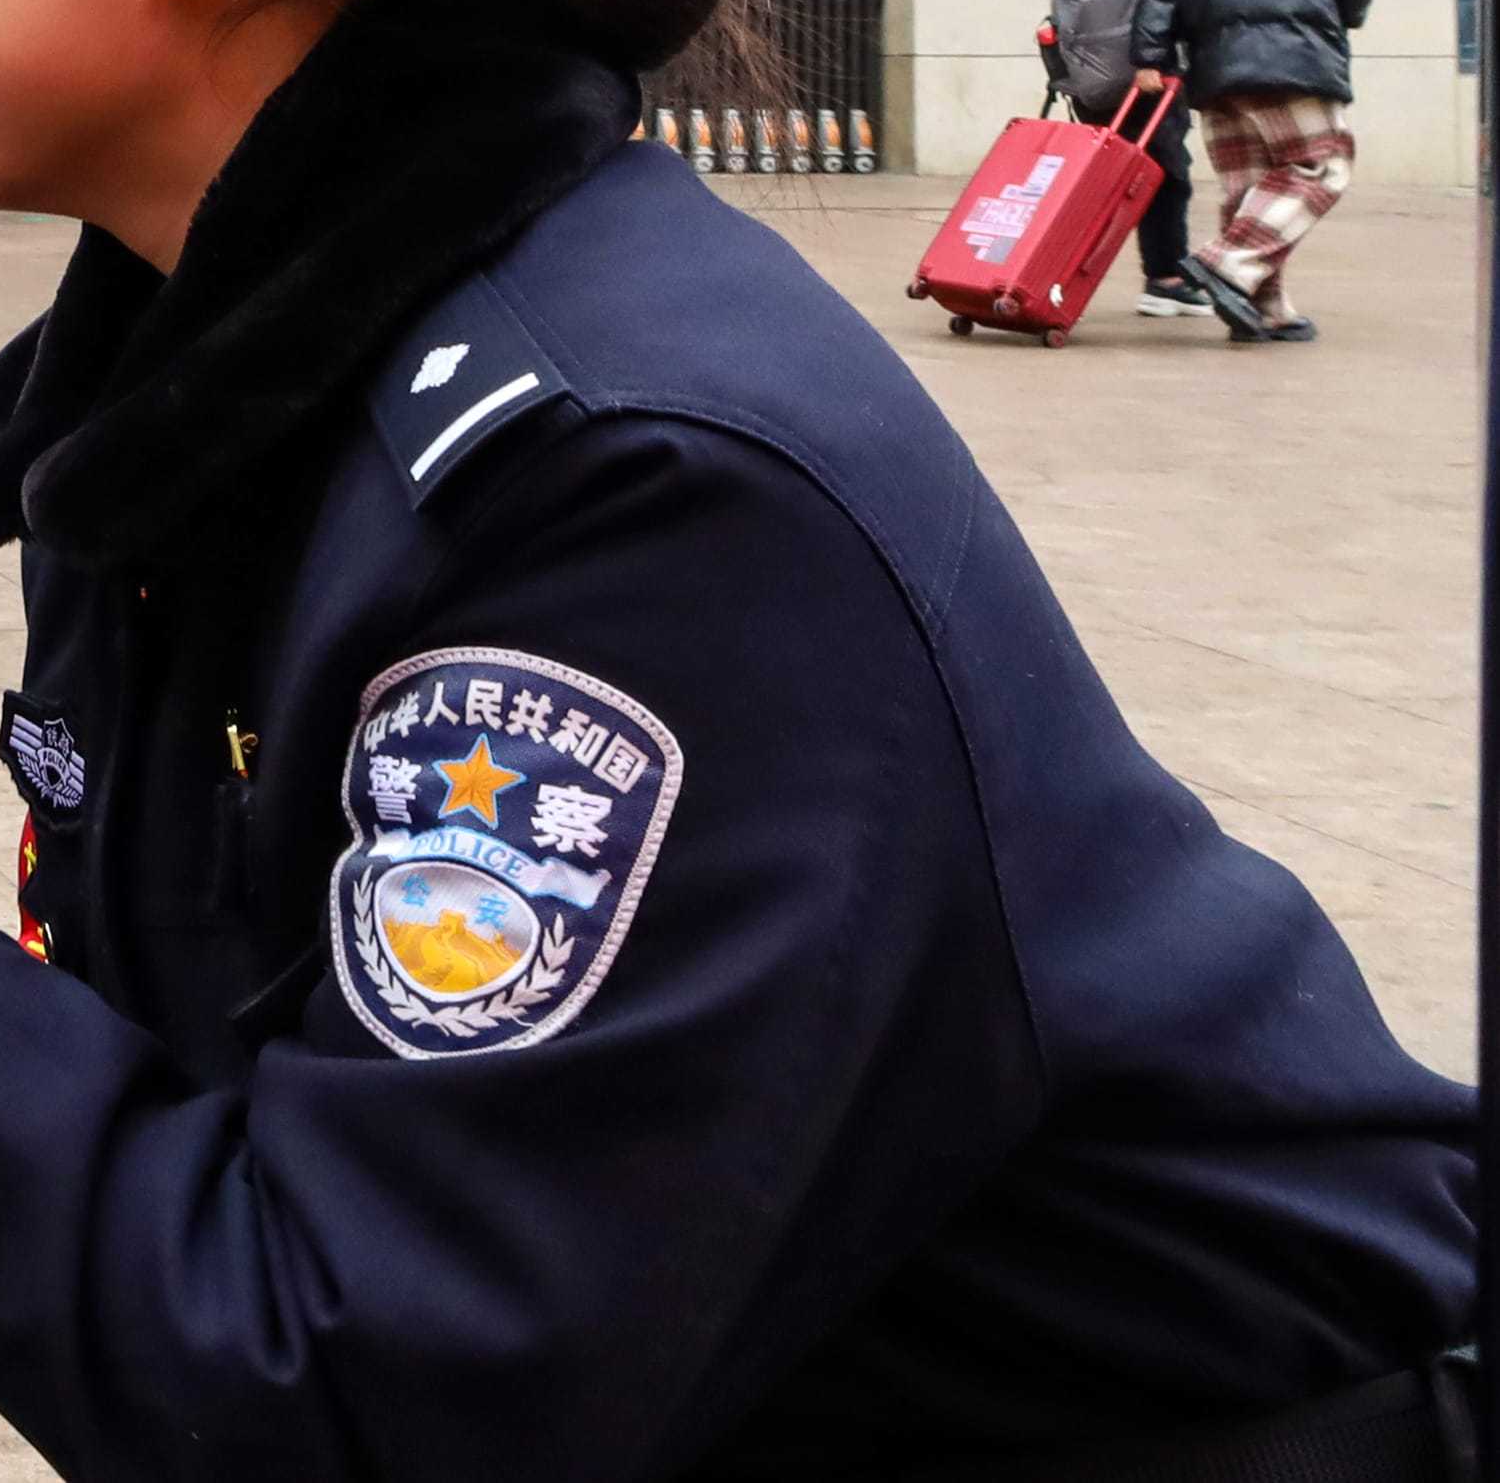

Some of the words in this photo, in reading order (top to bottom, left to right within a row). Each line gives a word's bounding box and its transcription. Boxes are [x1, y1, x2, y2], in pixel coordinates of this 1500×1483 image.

[364, 679, 650, 794] 中华人民共和国
[368, 754, 422, 825] 警
[530, 784, 614, 858] 察
[411, 830, 529, 880] POLICE
